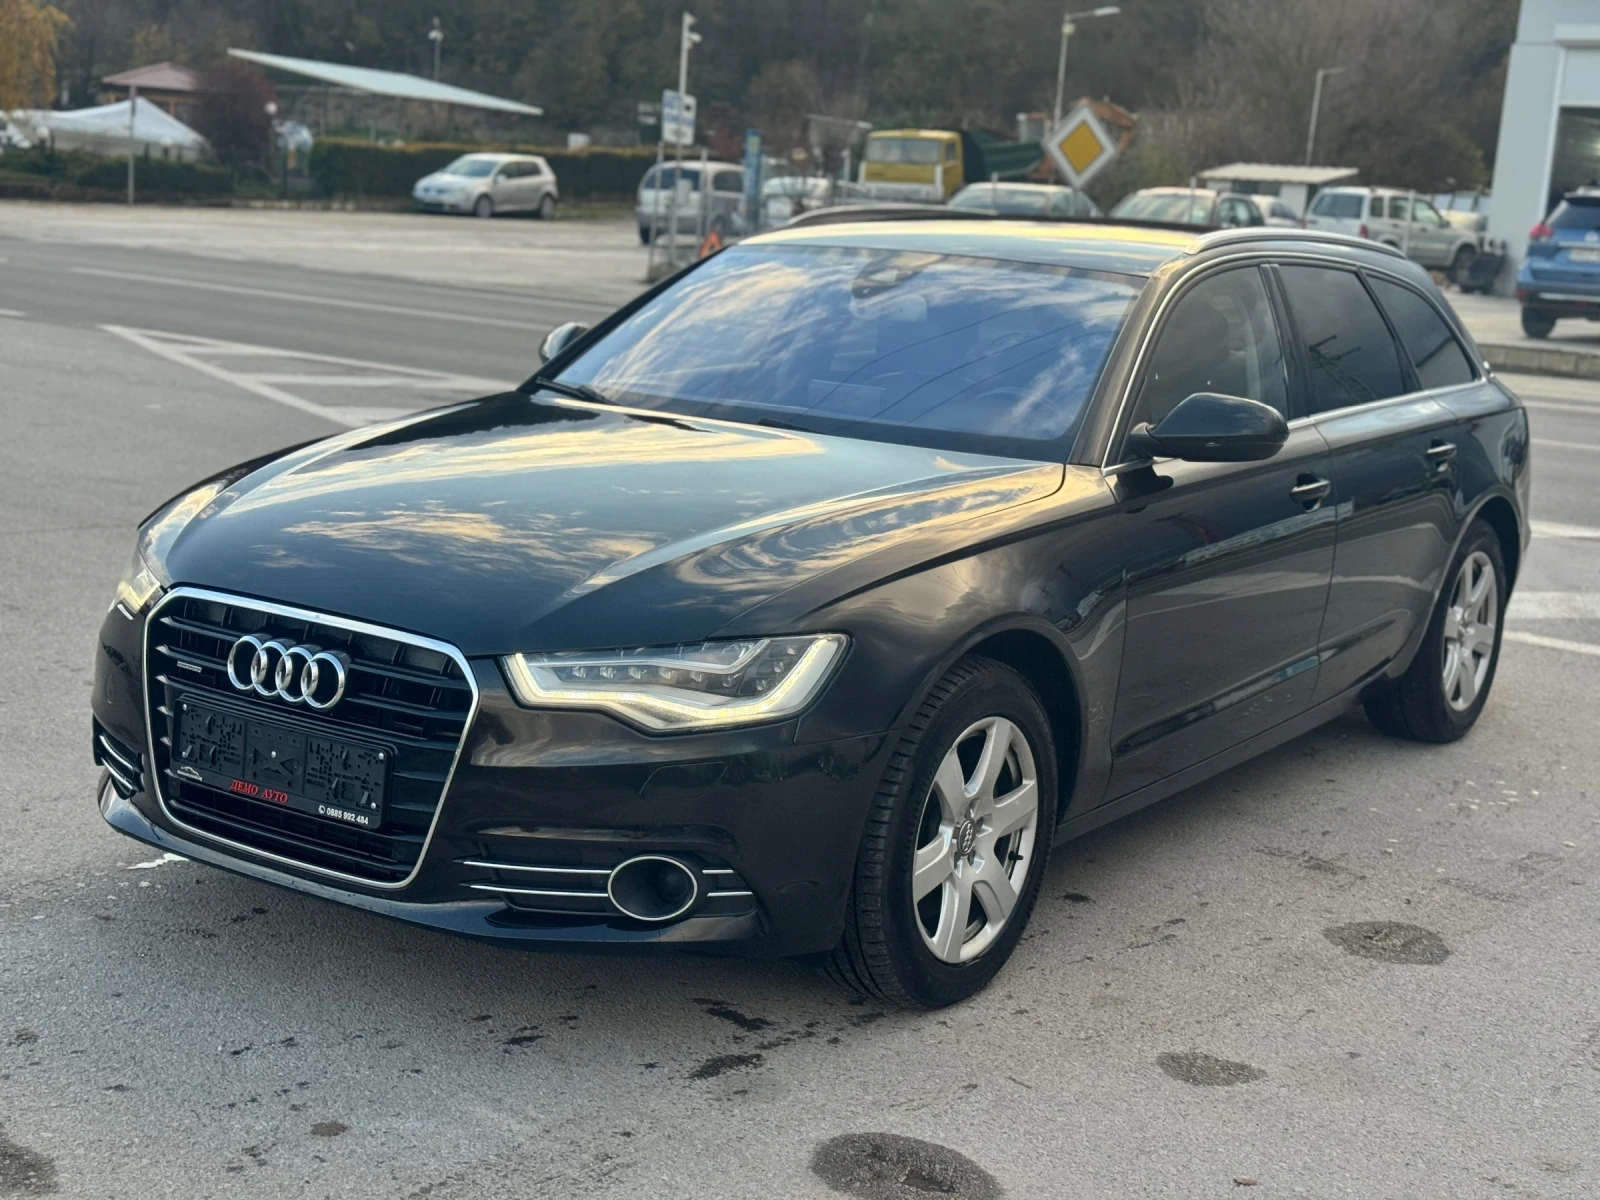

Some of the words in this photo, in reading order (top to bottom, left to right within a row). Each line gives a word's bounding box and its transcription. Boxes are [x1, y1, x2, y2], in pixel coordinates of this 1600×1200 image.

[326, 807, 342, 818] 0885
[343, 811, 355, 822] 992
[356, 815, 369, 825] 484
